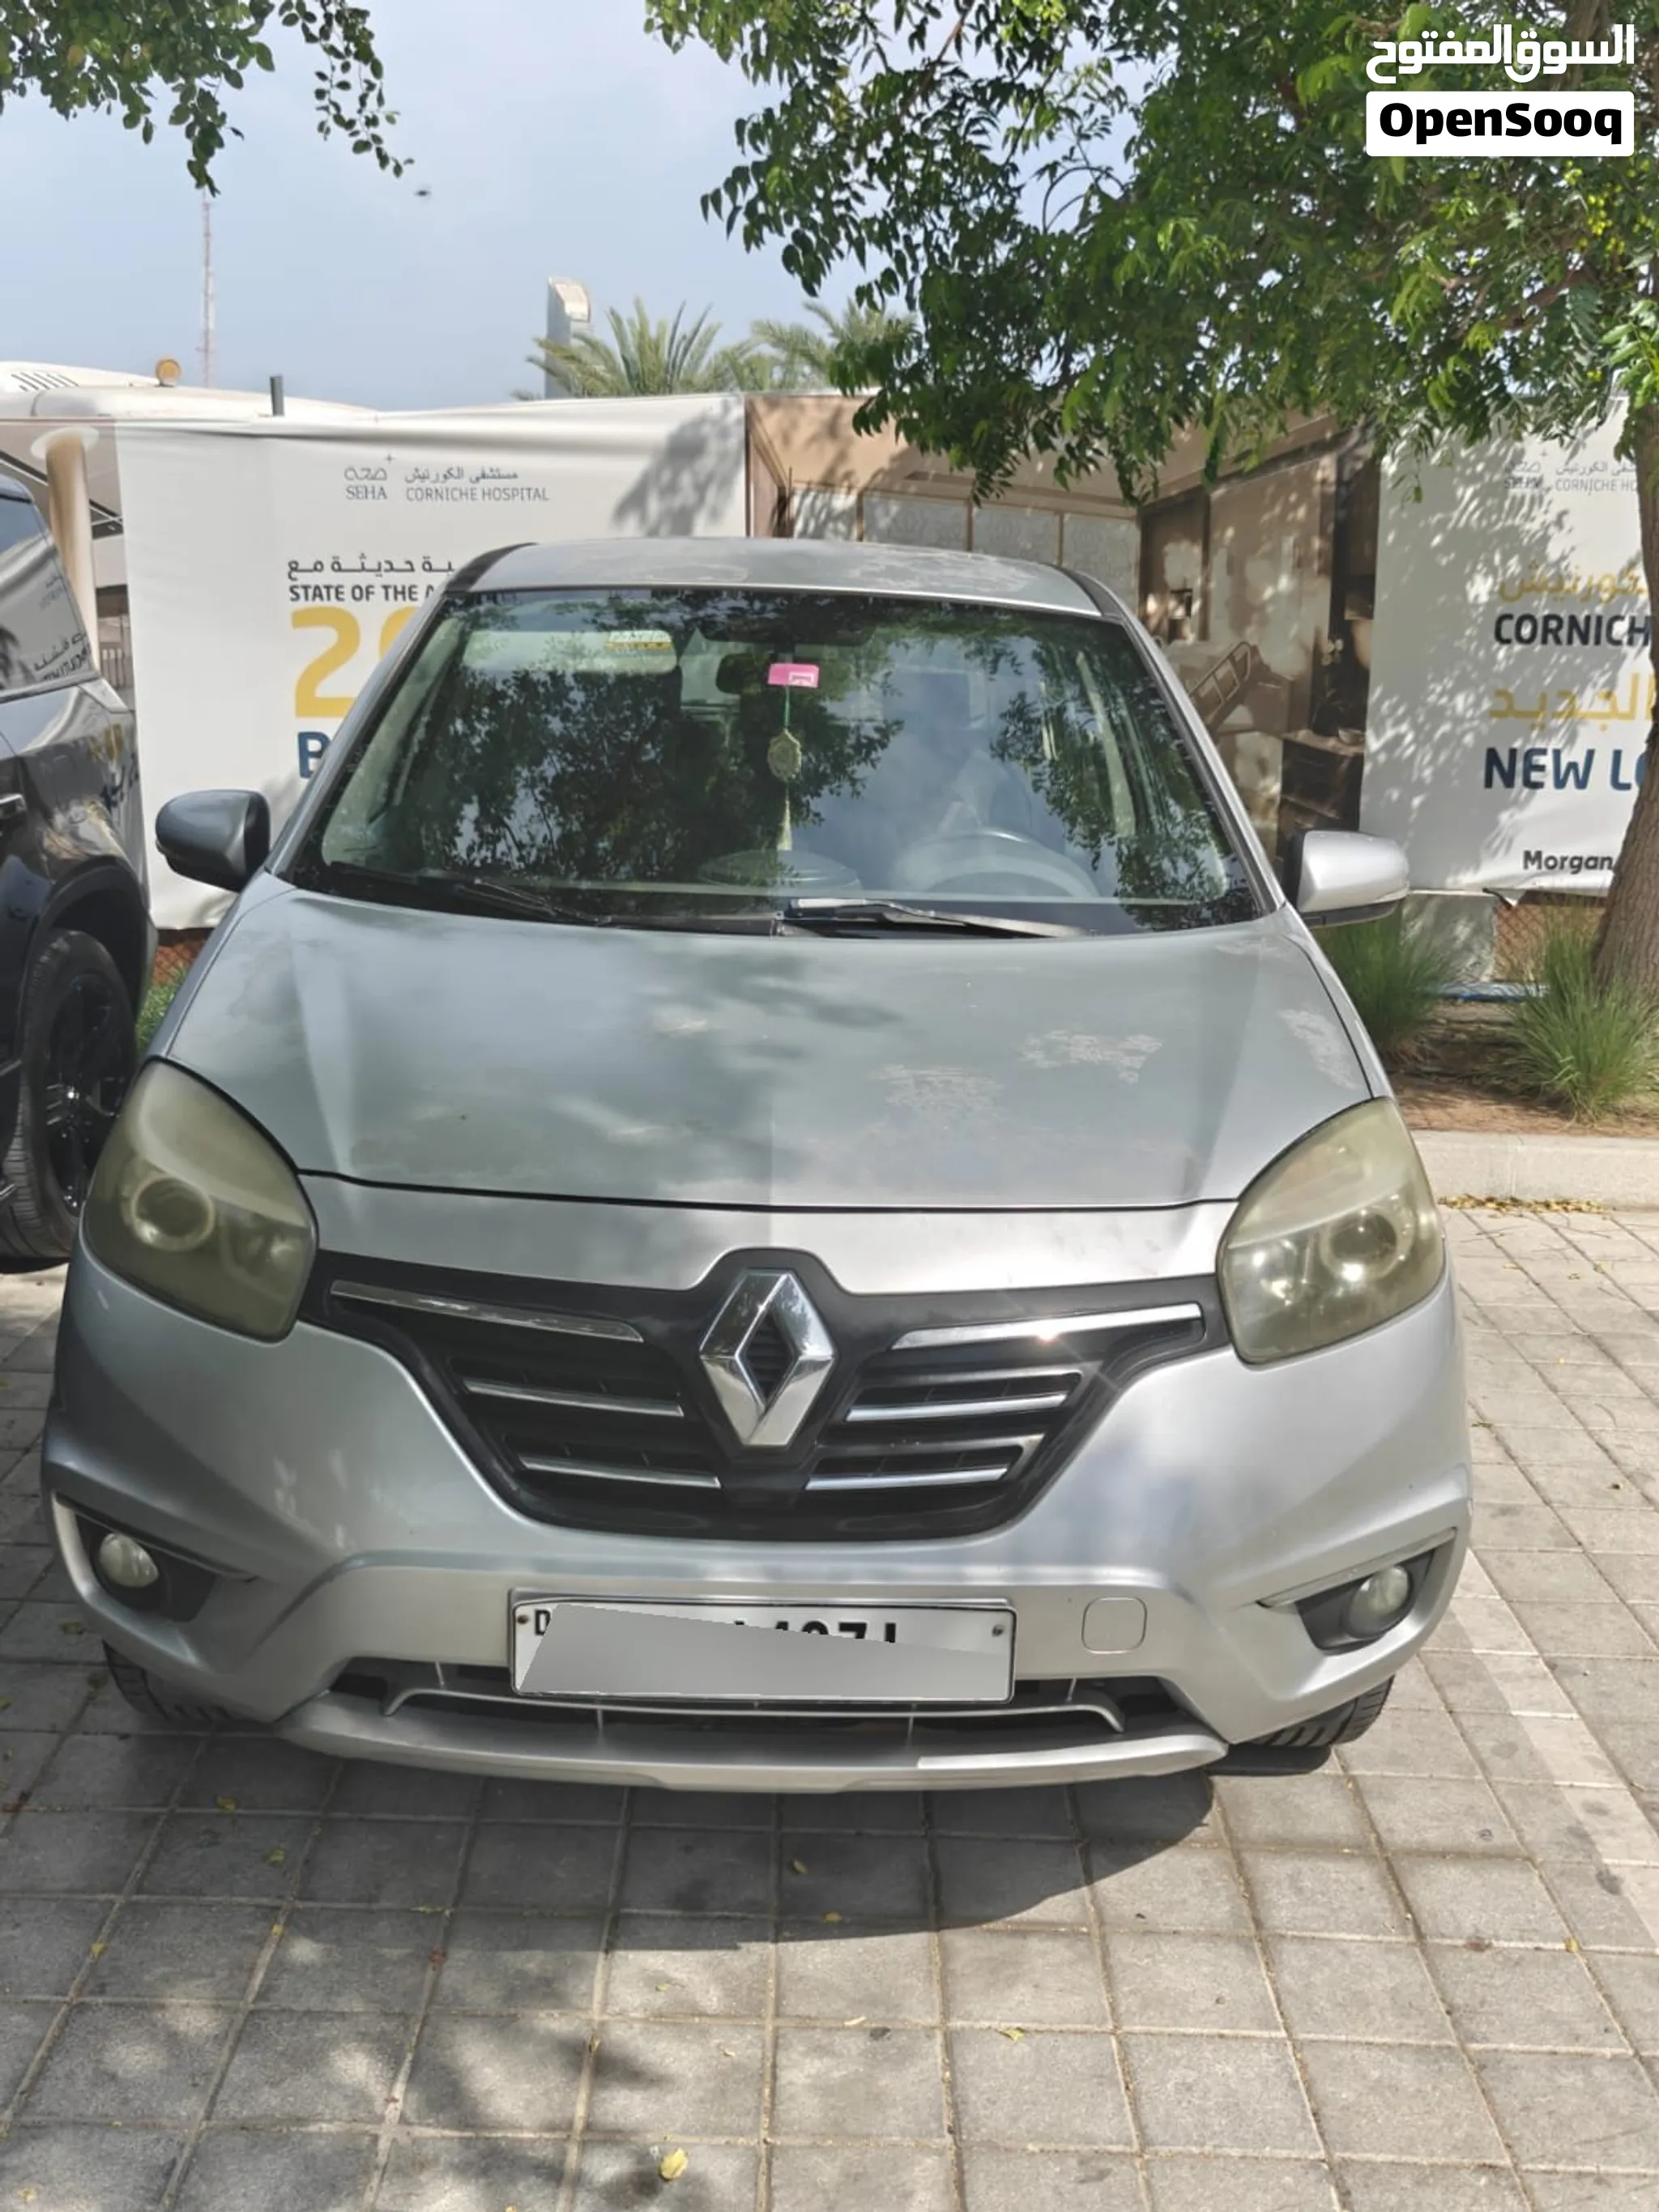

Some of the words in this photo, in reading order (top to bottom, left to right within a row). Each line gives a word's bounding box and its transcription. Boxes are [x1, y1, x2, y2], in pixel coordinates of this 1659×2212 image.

[344, 485, 388, 500] SEHA
[405, 486, 477, 502] CORNICHE
[481, 487, 550, 501] HOSPITAL
[1555, 478, 1618, 492] CORNICHE
[287, 559, 325, 582] مع
[331, 552, 416, 578] حديثة
[288, 584, 345, 602] STATE
[351, 584, 376, 602] OF
[381, 584, 419, 602] THE
[1494, 612, 1652, 646] CORNICH
[1484, 747, 1595, 791] NEW
[1522, 850, 1614, 875] Morgan
